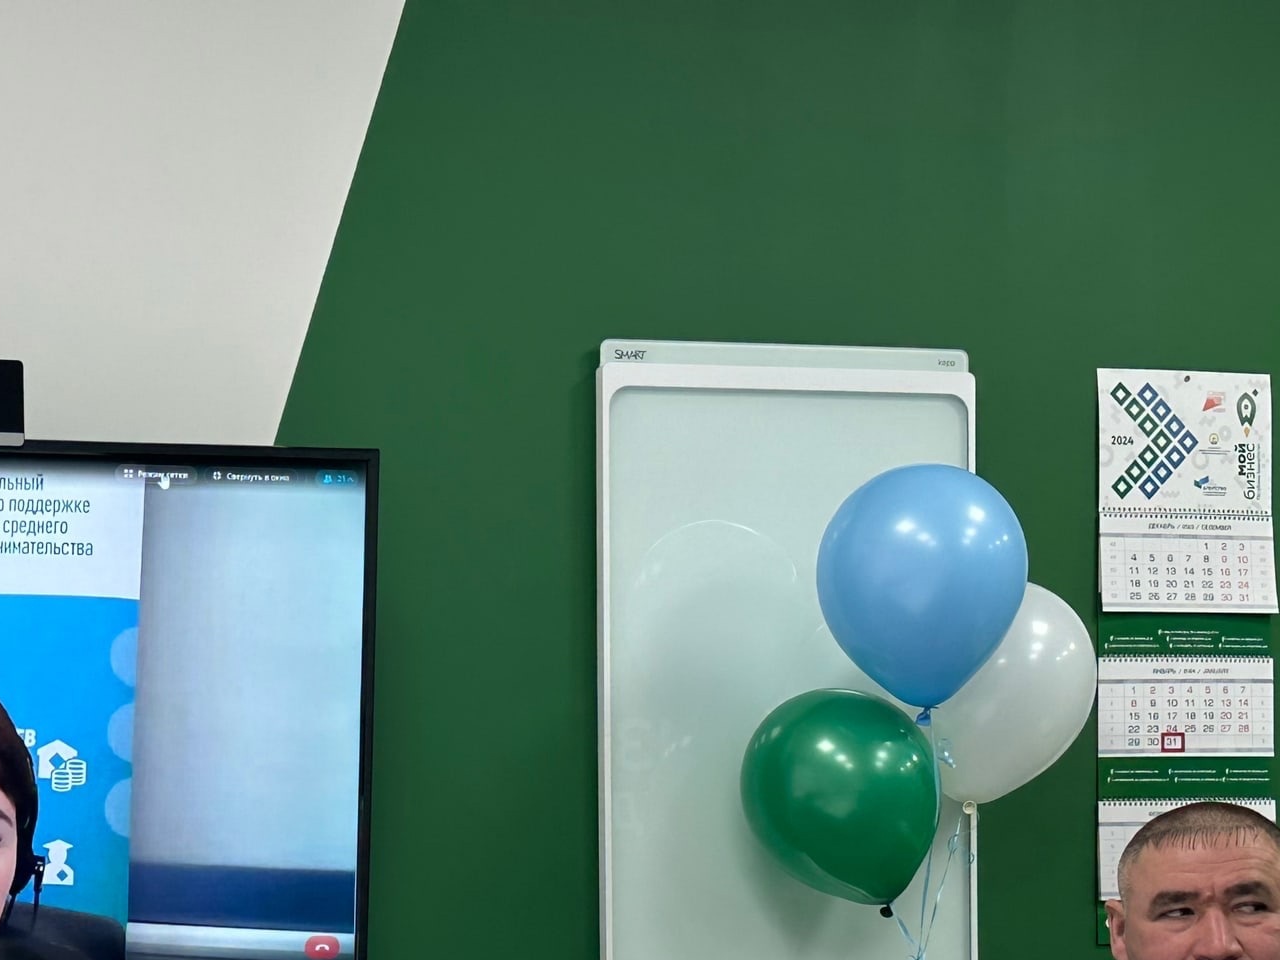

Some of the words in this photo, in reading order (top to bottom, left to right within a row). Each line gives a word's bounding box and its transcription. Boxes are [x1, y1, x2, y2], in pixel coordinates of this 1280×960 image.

[614, 349, 647, 360] SMART
[1111, 435, 1134, 446] 2024
[1234, 443, 1246, 476] мой
[1243, 443, 1256, 500] бизнес
[8, 498, 91, 517] поддержке
[2, 519, 68, 537] среднего
[1147, 567, 1158, 575] 12
[1166, 567, 1176, 575] 13
[1220, 568, 1231, 576] 16
[1166, 580, 1178, 588] 20
[1220, 581, 1231, 589] 23
[1238, 581, 1249, 589] 24
[1130, 592, 1142, 600] 25
[1184, 593, 1196, 601] 28
[1203, 593, 1214, 601] 29
[1221, 593, 1232, 601] 30
[1168, 699, 1178, 707] 10
[1185, 699, 1195, 707] 11
[1148, 712, 1159, 720] 16
[1168, 712, 1177, 720] 17
[1185, 712, 1196, 720] 18
[1147, 725, 1159, 733] 23
[1166, 725, 1178, 733] 24
[1128, 738, 1140, 746] 29
[1147, 738, 1159, 746] 30
